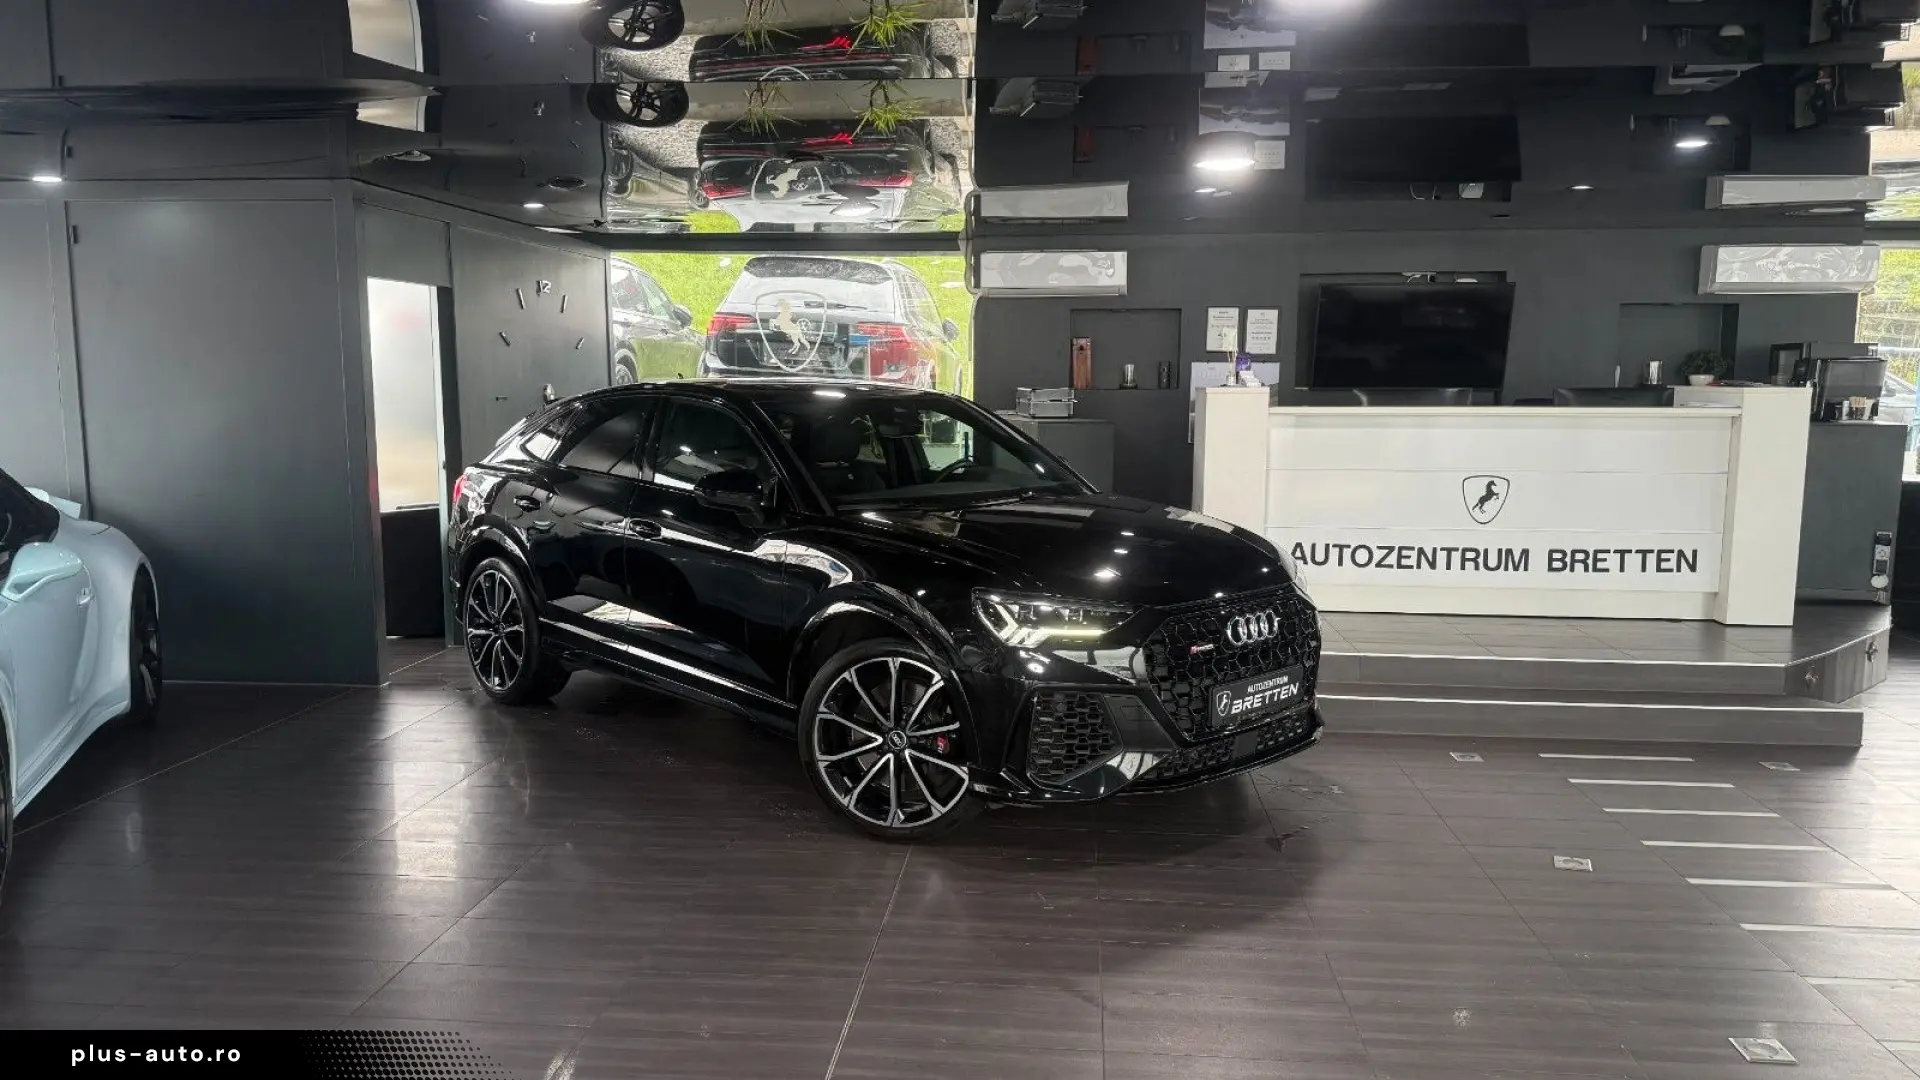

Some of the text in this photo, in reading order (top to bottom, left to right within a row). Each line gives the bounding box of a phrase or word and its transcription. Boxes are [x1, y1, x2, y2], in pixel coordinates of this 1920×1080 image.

[536, 279, 552, 295] 12
[1290, 541, 1699, 574] AUTOZENTRUM BRETTEN
[1247, 675, 1289, 694] AUTOZENTRUM
[1231, 682, 1299, 715] BRETTEN
